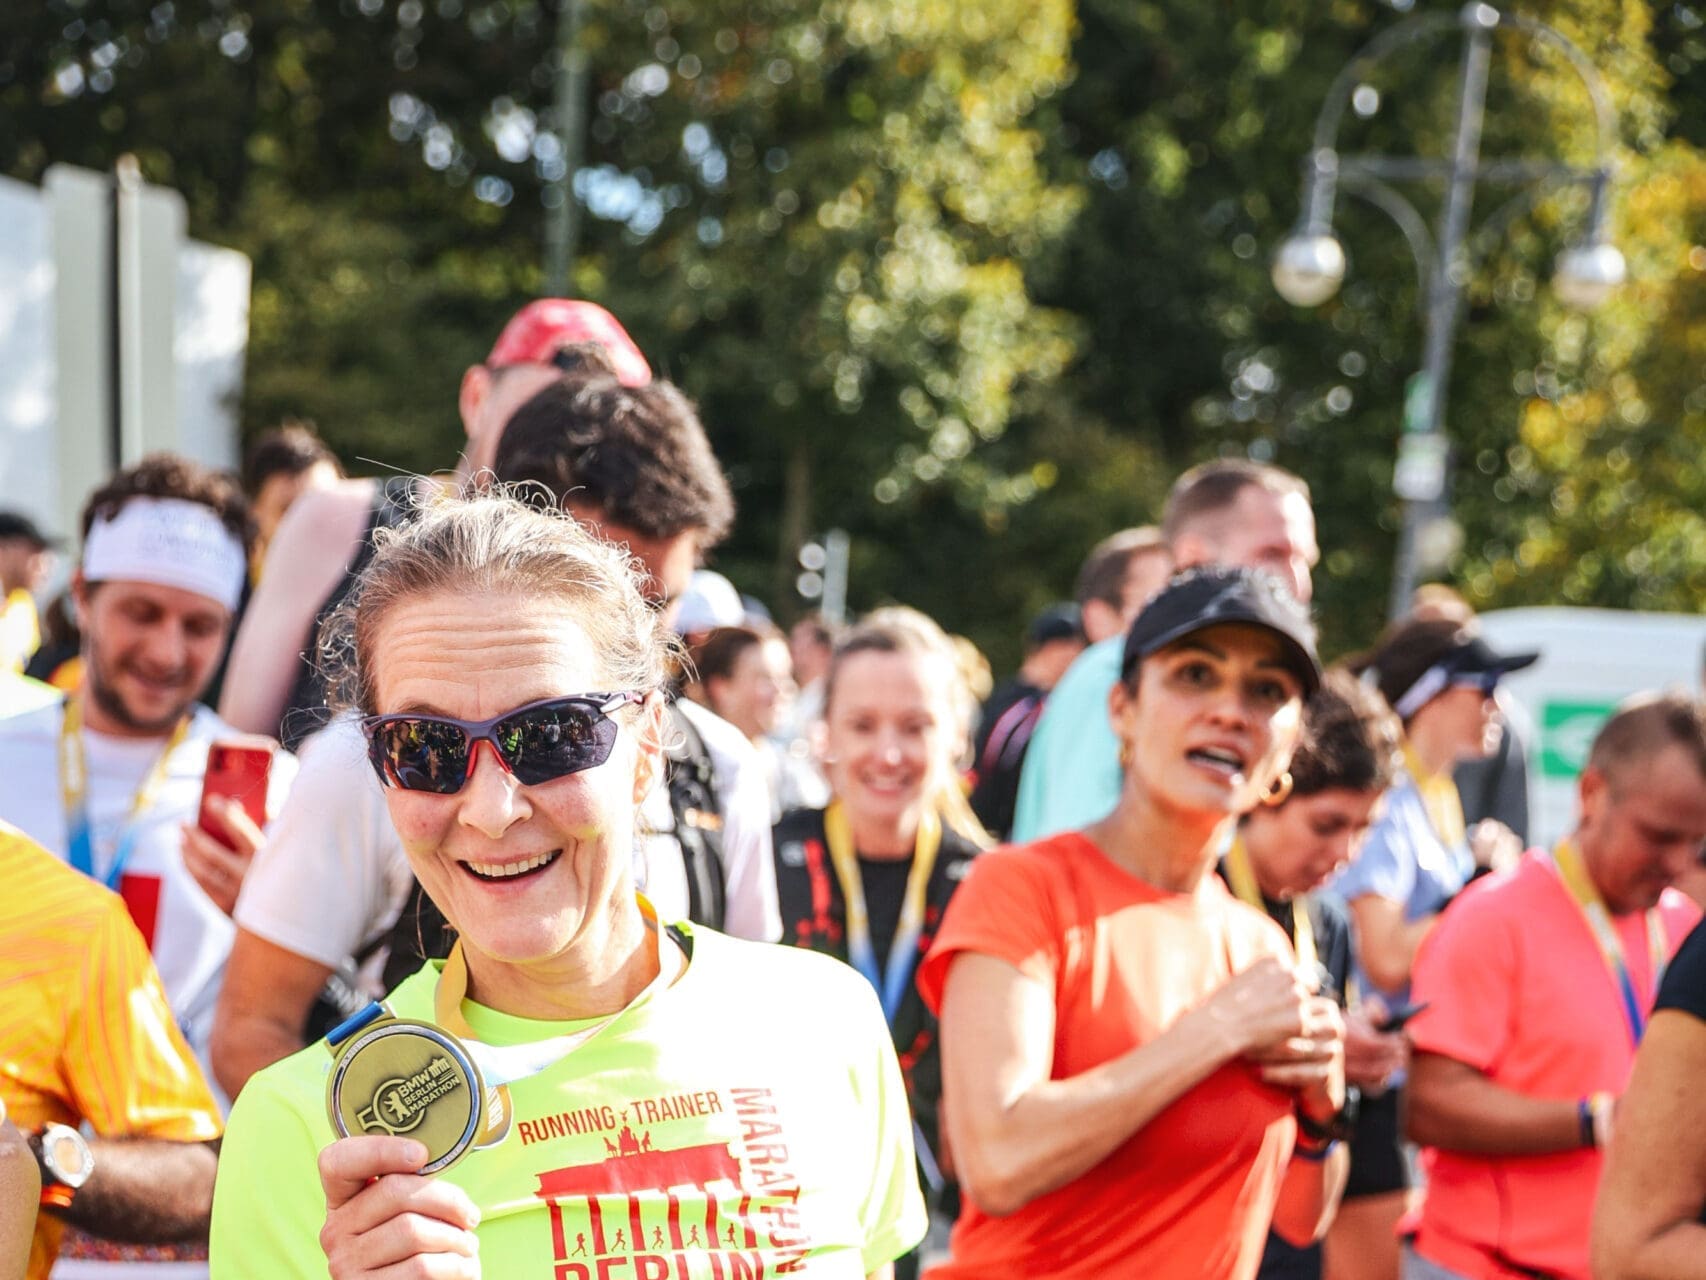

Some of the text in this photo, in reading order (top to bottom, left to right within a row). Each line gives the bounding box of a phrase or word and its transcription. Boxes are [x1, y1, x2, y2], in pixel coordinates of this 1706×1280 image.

[399, 1068, 431, 1097] BMW
[404, 1079, 438, 1106] BERLIN
[408, 1076, 461, 1115] MARATHON
[517, 1105, 617, 1146] RUNNING
[630, 1090, 724, 1126] TRAINER
